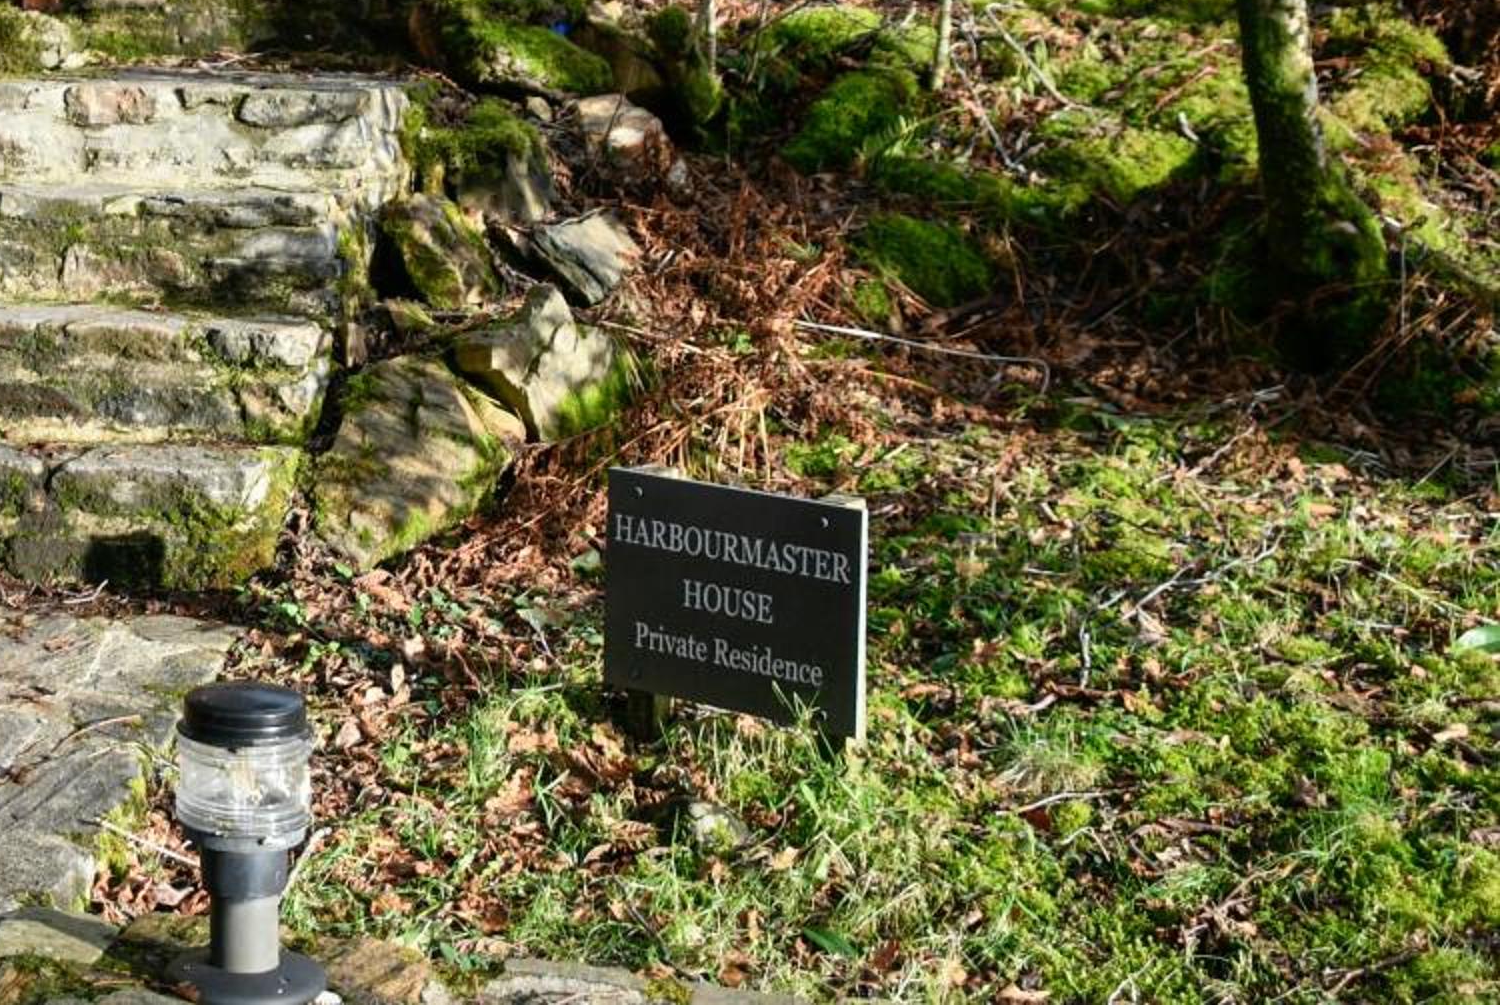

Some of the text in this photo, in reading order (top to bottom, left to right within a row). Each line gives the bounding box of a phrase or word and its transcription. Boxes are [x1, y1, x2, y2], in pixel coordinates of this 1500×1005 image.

[615, 514, 851, 584] HARBOURMASTER
[684, 579, 774, 624] HOUSE
[635, 623, 823, 687] Private Residence
